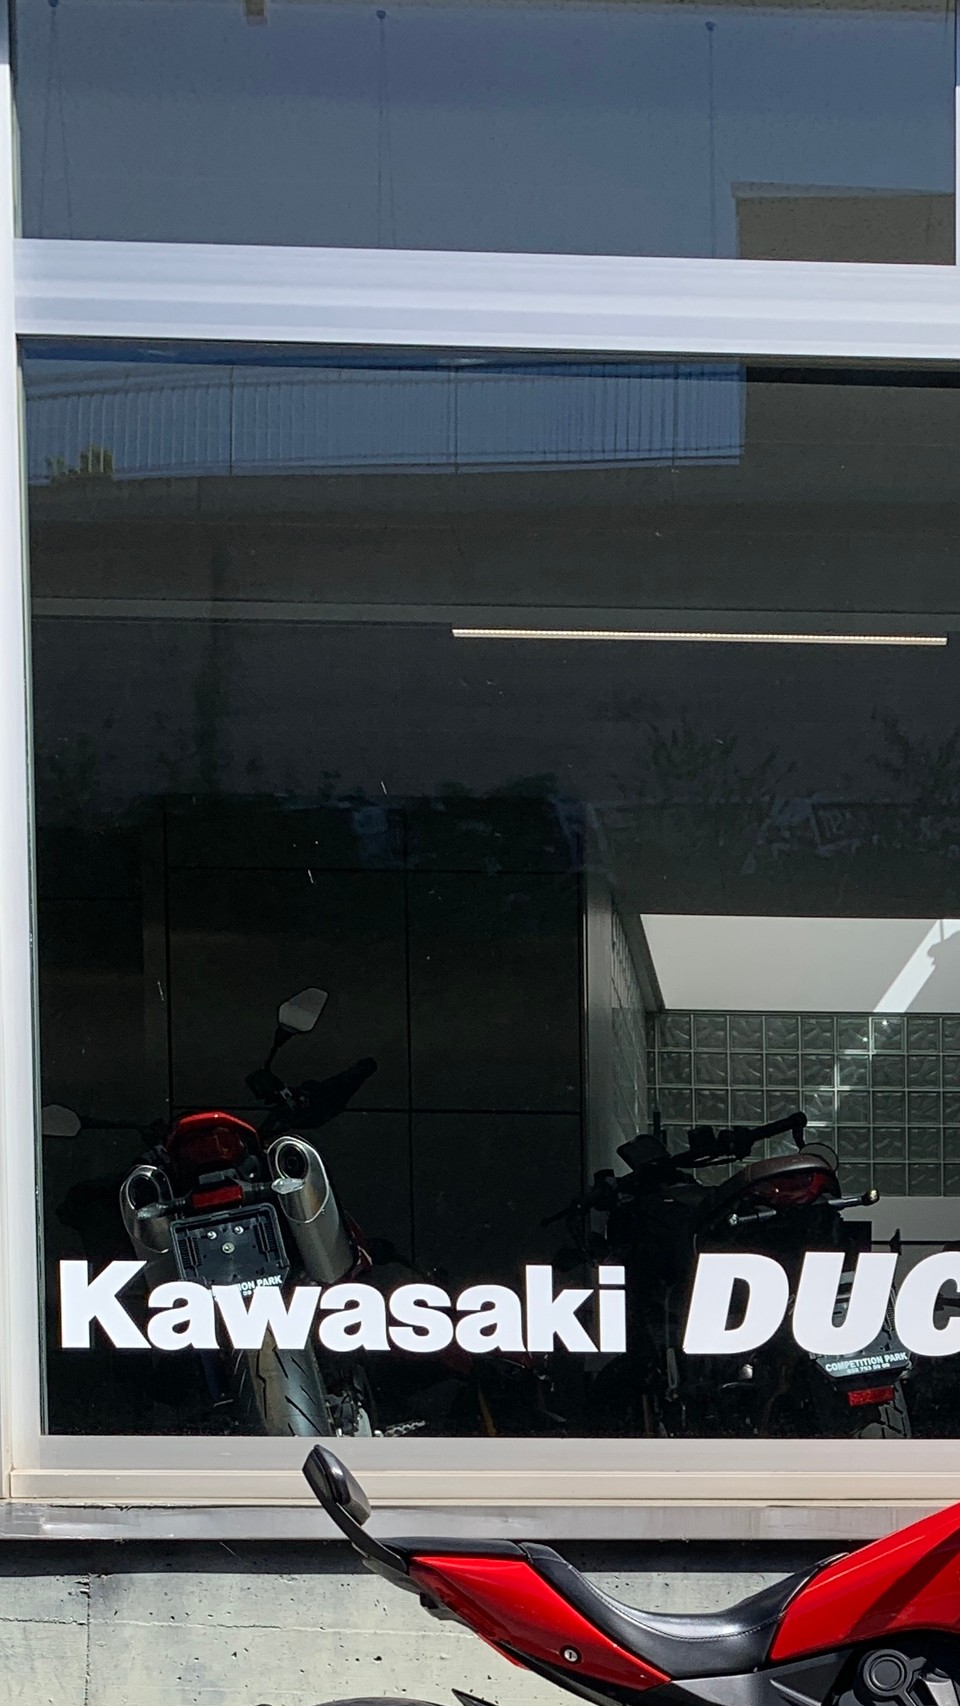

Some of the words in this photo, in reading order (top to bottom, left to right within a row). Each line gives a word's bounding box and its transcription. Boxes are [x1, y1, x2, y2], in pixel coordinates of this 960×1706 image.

[60, 1260, 626, 1353] Kawasaki
[825, 1355, 884, 1372] COMPETITION
[884, 1351, 908, 1363] PARK
